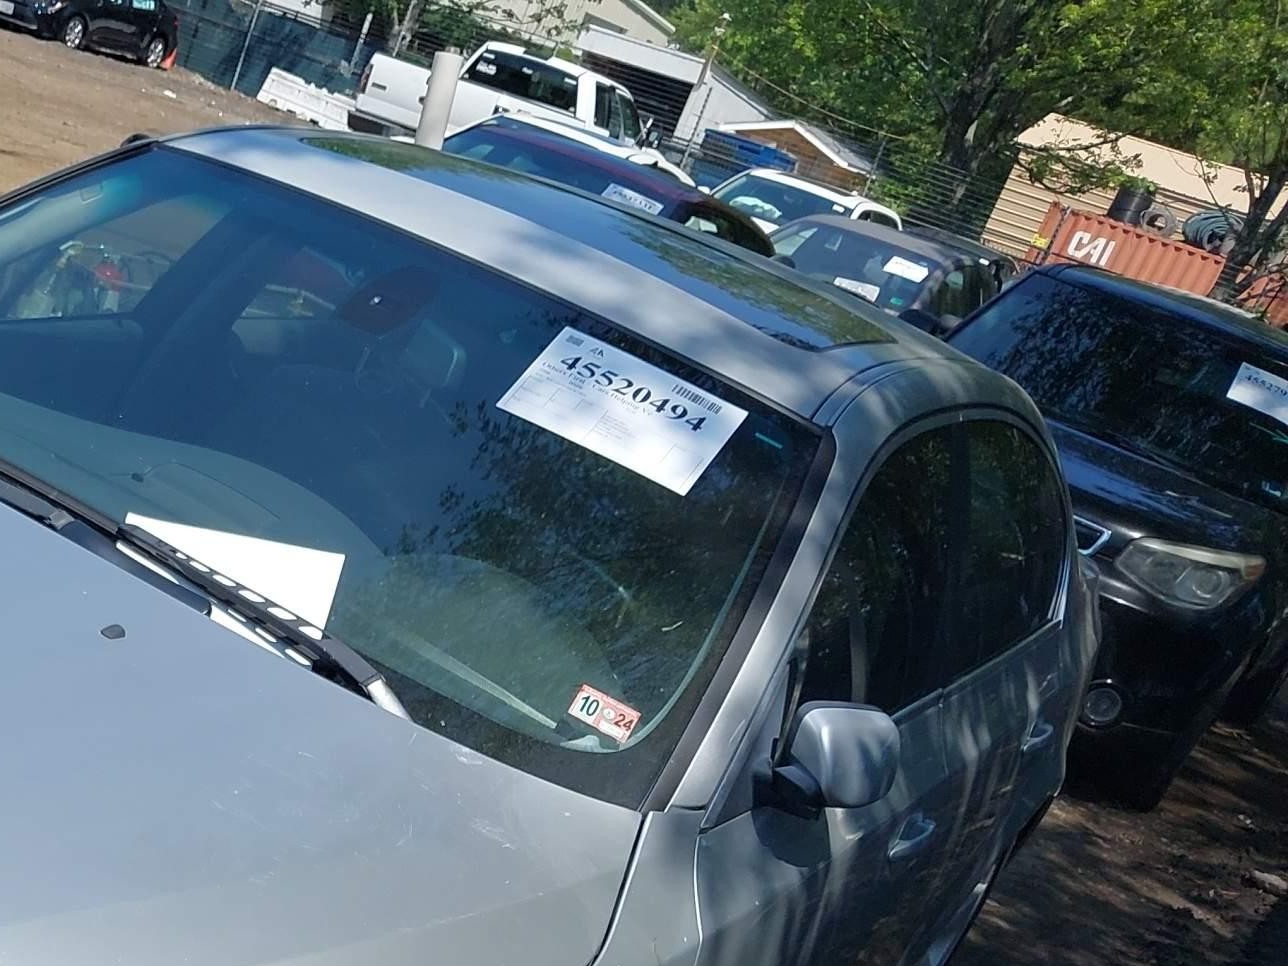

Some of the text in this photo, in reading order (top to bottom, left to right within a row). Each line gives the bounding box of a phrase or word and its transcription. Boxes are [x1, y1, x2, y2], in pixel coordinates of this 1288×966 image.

[1067, 230, 1116, 267] CAI
[559, 355, 709, 433] 45520494
[579, 695, 600, 717] 10
[614, 713, 634, 732] 24
